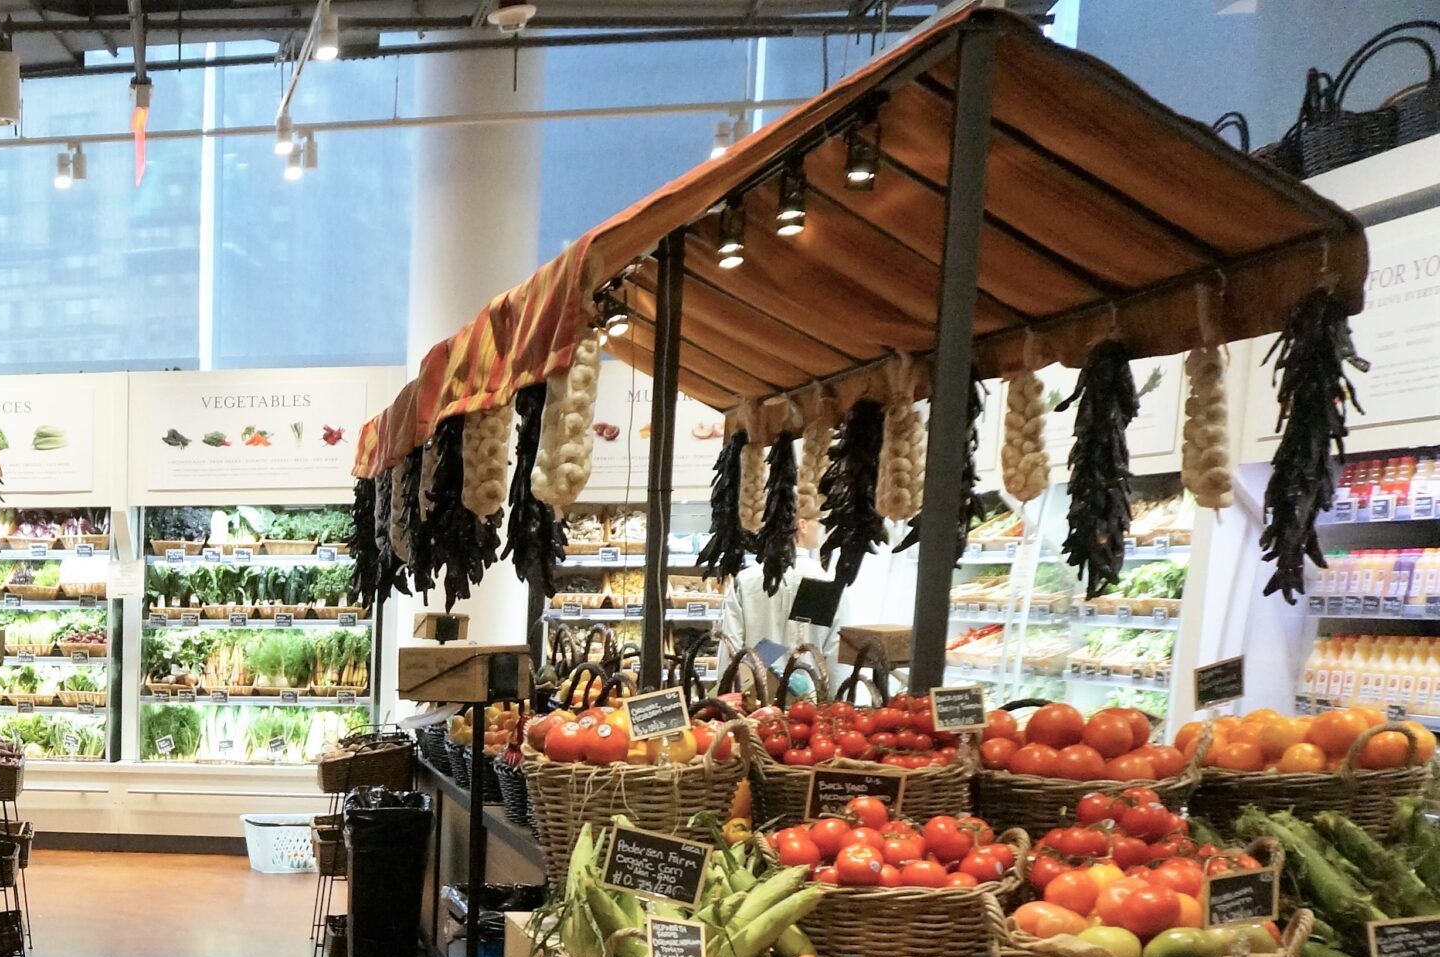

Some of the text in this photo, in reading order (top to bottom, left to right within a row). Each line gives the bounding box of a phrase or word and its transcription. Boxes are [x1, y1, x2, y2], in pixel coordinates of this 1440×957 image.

[201, 394, 311, 409] VEGETABLES
[617, 839, 697, 869] Pedersen Farm
[681, 843, 705, 856] Local
[615, 854, 684, 878] Organic Corn
